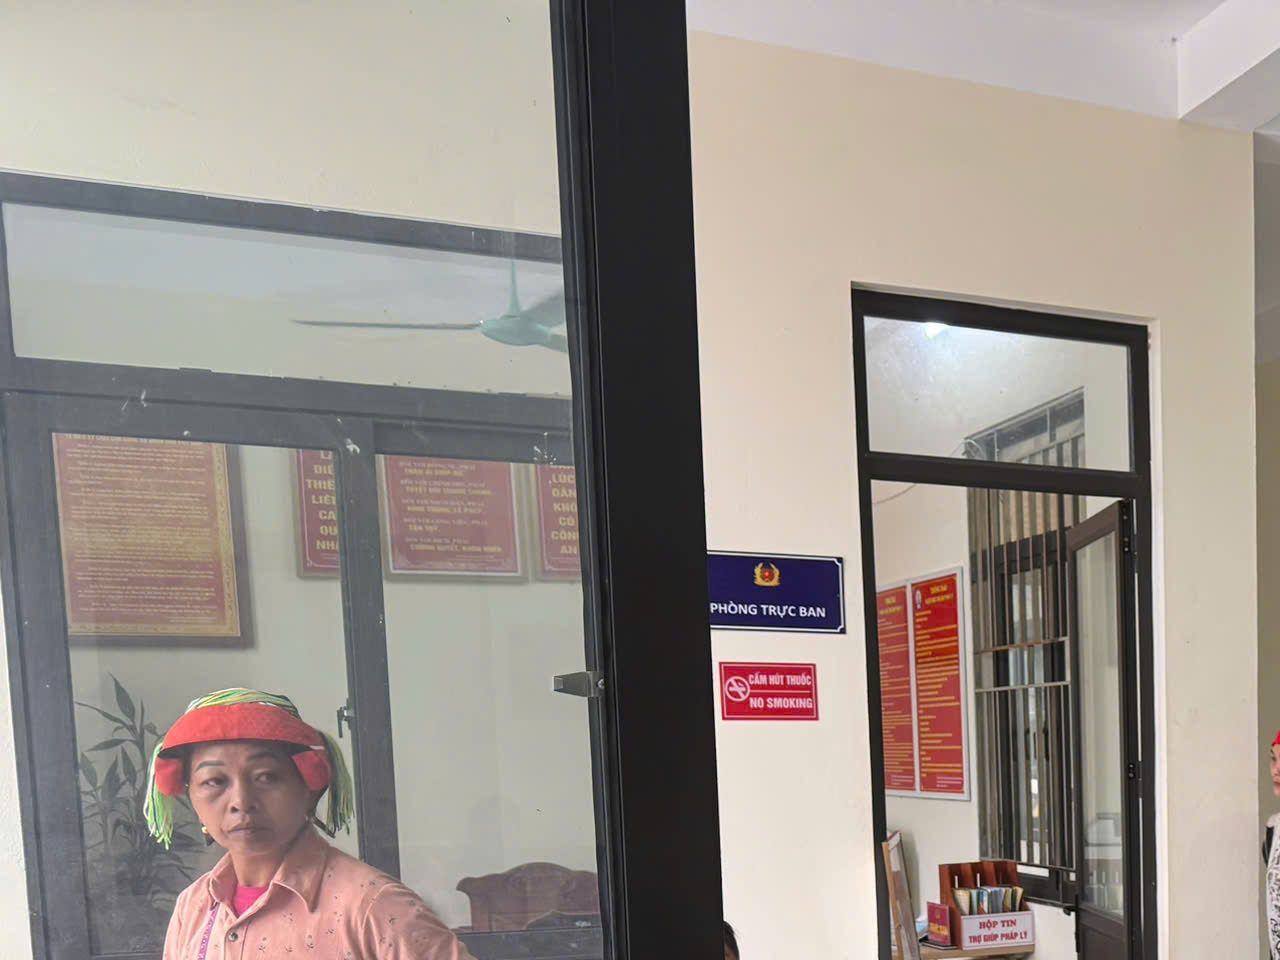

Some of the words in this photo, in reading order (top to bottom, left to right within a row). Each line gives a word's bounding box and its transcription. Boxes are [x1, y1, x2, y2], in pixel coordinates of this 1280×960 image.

[709, 601, 758, 615] PHÒNG
[760, 604, 797, 618] TRỰC
[799, 606, 826, 617] BAN
[748, 671, 768, 685] CẤM
[769, 671, 785, 685] HÚT
[786, 671, 812, 685] THUỐC
[749, 697, 764, 708] NO
[766, 697, 813, 709] SMOKING
[979, 919, 998, 930] HỘP
[1000, 919, 1017, 928] TIN
